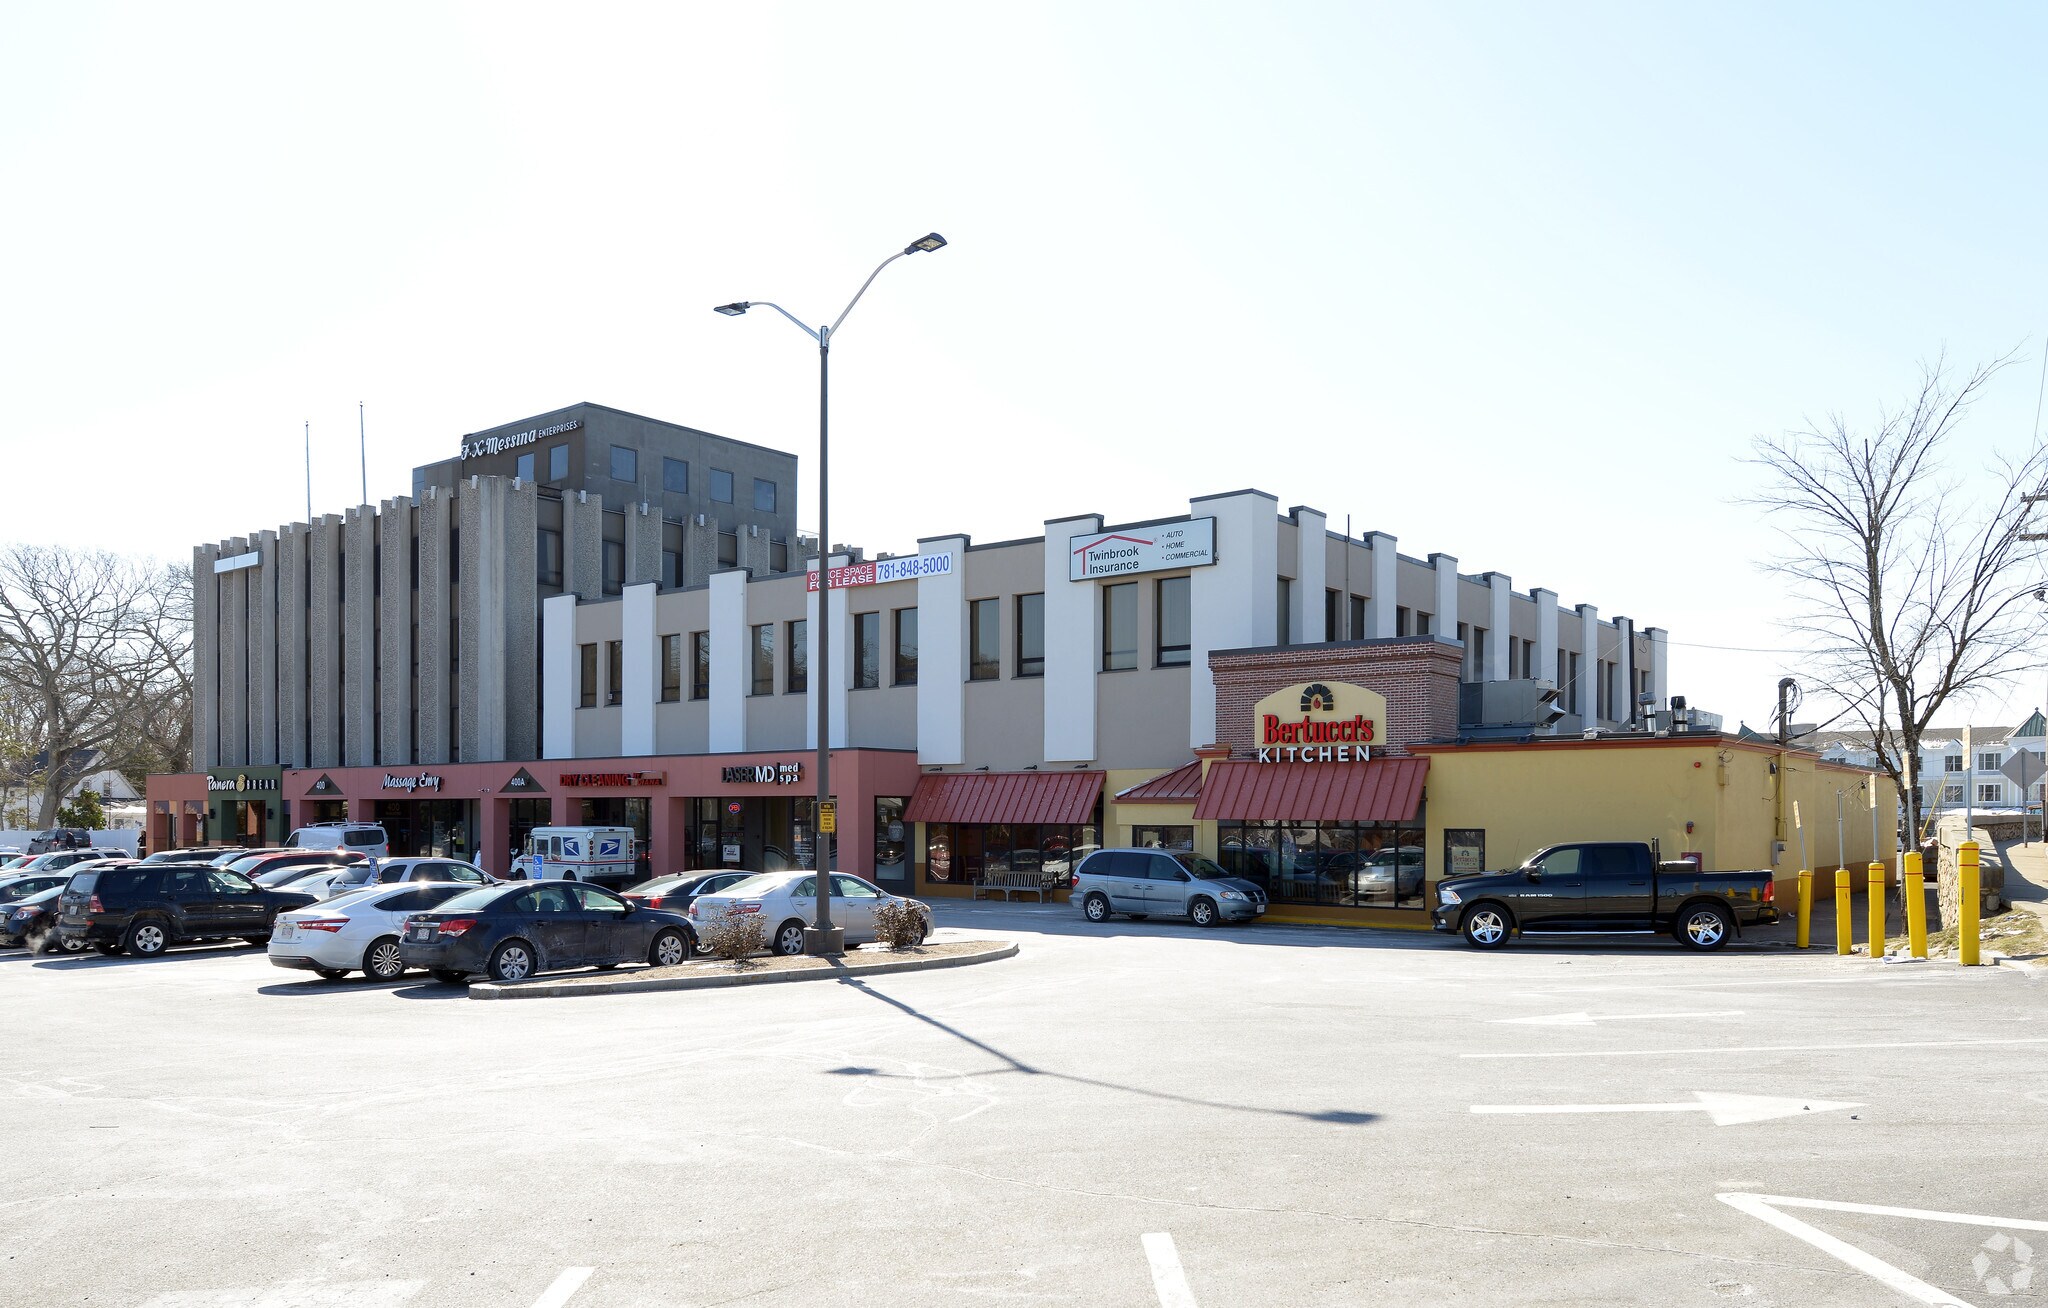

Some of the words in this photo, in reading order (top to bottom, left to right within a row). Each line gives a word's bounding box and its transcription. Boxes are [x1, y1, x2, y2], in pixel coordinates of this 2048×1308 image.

[1166, 530, 1184, 539] AUTO
[1166, 541, 1185, 550] HOME
[1088, 546, 1139, 562] Twinbrook
[1165, 549, 1209, 561] COMMERCIAL
[844, 565, 873, 577] SPACE
[877, 555, 950, 580] 781-848-5000
[1089, 560, 1139, 575] Insurance
[836, 574, 874, 587] LEASE
[1262, 714, 1374, 745] Bertucci's
[1258, 745, 1370, 763] KITCHEN
[780, 762, 799, 773] med
[206, 775, 236, 791] Panera
[246, 779, 276, 790] BREAD
[316, 781, 326, 790] 400
[380, 773, 417, 793] Massage
[418, 772, 441, 793] Envy
[510, 778, 526, 787] 400A
[560, 773, 579, 787] DRY
[581, 773, 629, 787] CLEANING
[780, 774, 799, 785] spa
